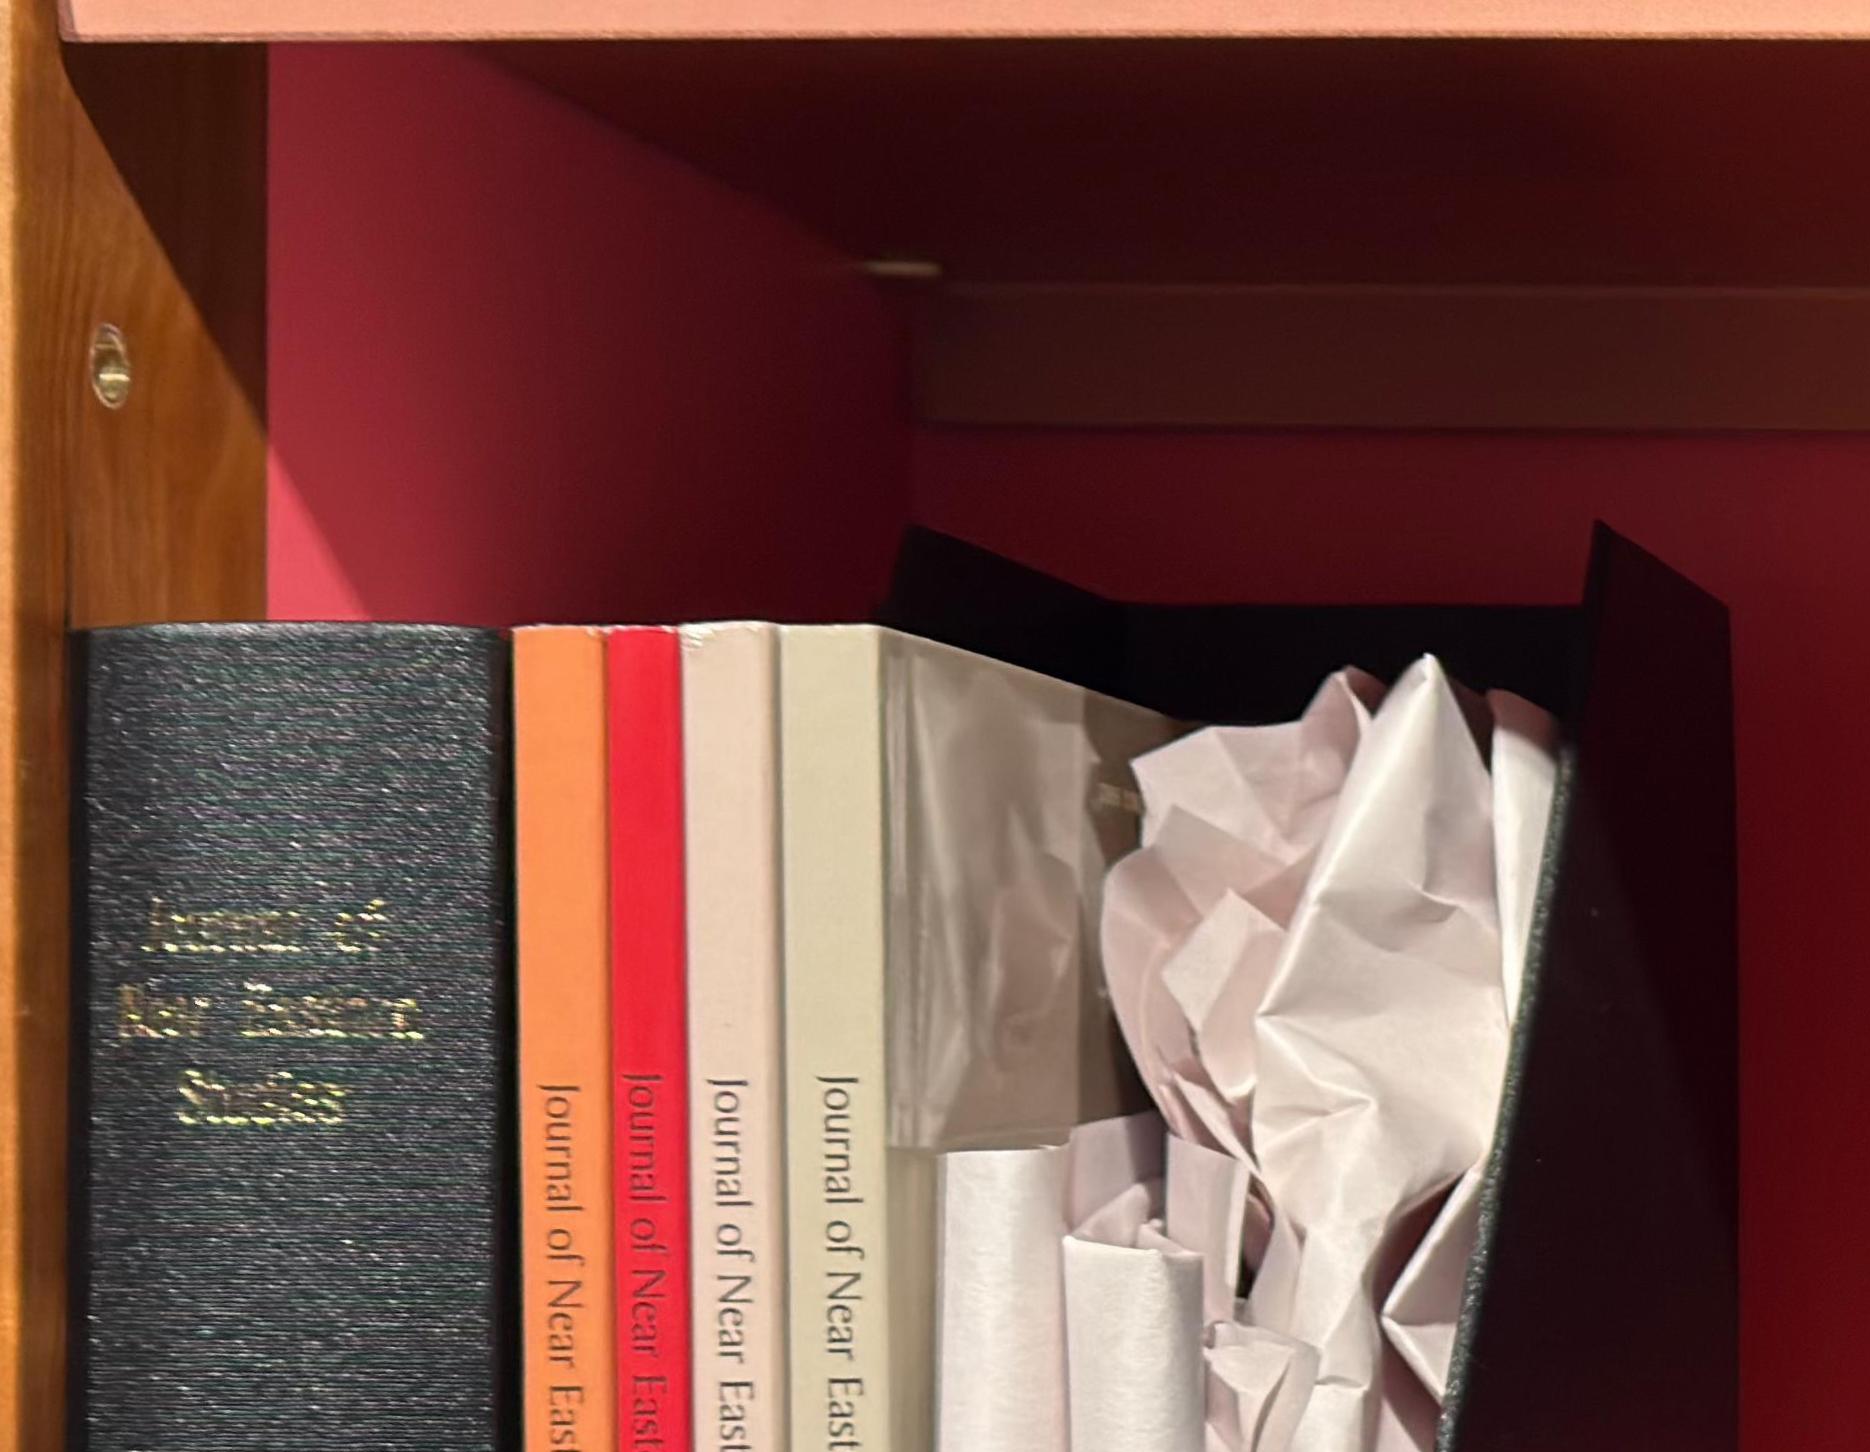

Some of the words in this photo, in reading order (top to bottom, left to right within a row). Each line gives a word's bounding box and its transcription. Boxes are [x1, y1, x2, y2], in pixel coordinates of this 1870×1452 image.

[537, 1084, 585, 1213] Journal
[622, 1074, 667, 1202] Journal
[706, 1078, 753, 1207] Journal
[815, 1076, 864, 1204] Journal
[548, 1229, 588, 1268] of
[630, 1218, 669, 1258] of
[715, 1224, 757, 1264] of
[825, 1221, 867, 1262] of
[547, 1281, 584, 1369] Near
[632, 1269, 668, 1359] Near
[717, 1275, 754, 1366] Near
[826, 1272, 864, 1362] Near
